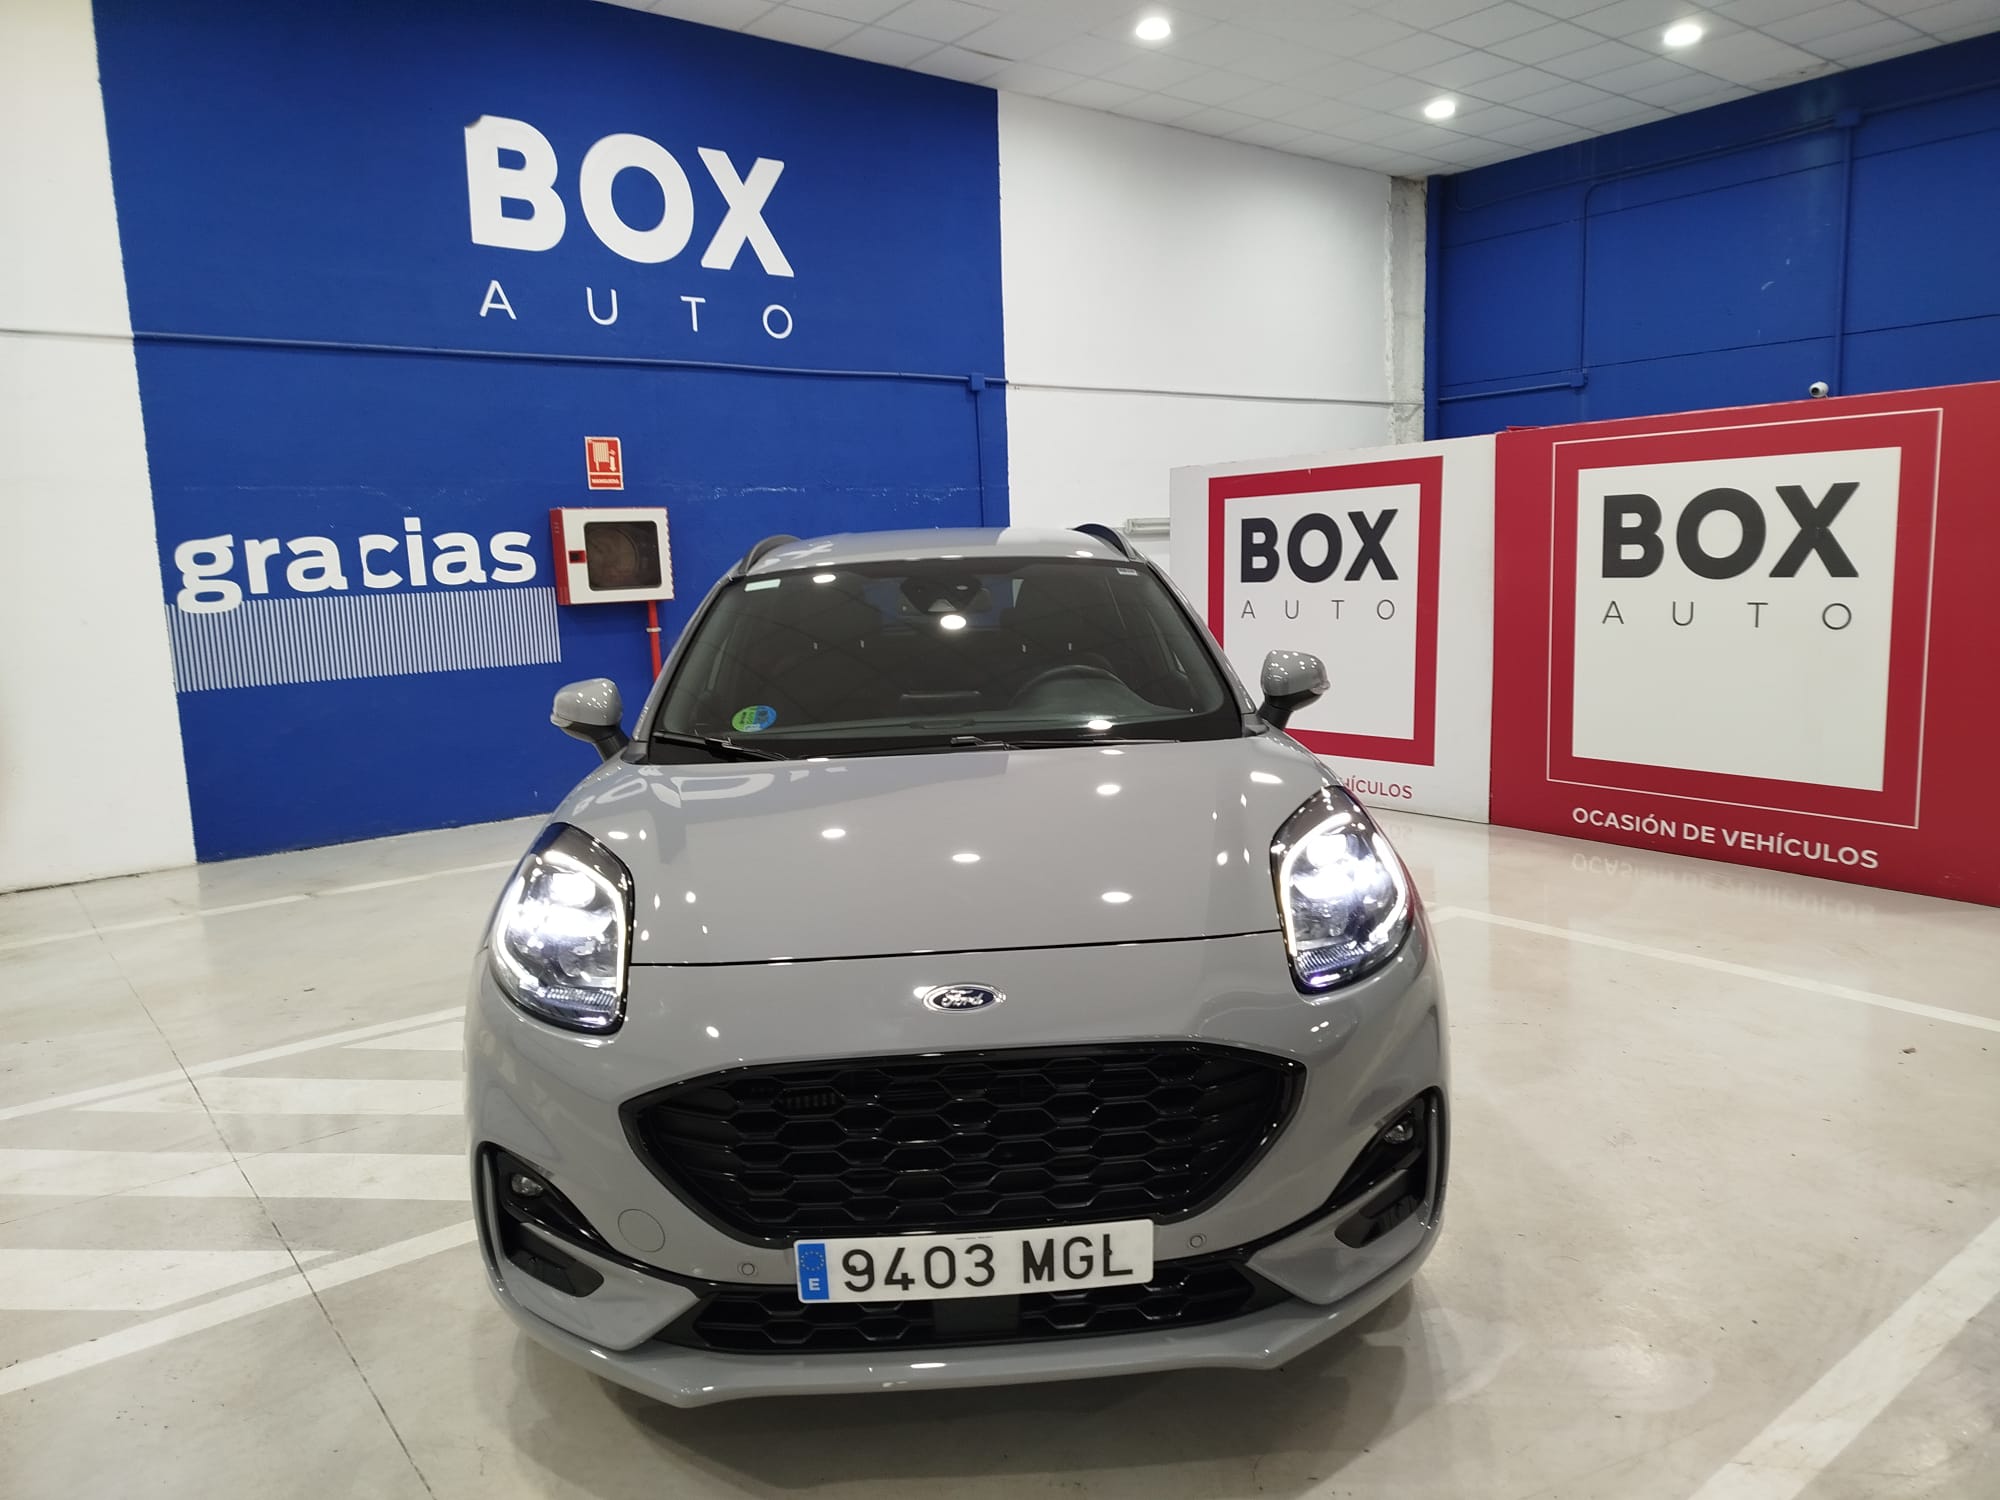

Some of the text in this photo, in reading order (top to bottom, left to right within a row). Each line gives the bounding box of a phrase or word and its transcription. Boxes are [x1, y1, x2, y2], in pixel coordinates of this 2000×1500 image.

[464, 114, 795, 277] BOX
[479, 279, 794, 340] AUTO
[1240, 508, 1399, 583] BOX
[1601, 482, 1861, 579] BOX
[174, 516, 537, 615] gracias
[1240, 598, 1397, 621] AUTO
[1601, 600, 1853, 631] AUTO
[1571, 807, 1880, 870] OCASIÓN DE VEHÍCULOS
[941, 989, 984, 1007] Ford
[808, 1277, 821, 1292] E
[842, 1233, 1134, 1293] 9403 MGL
